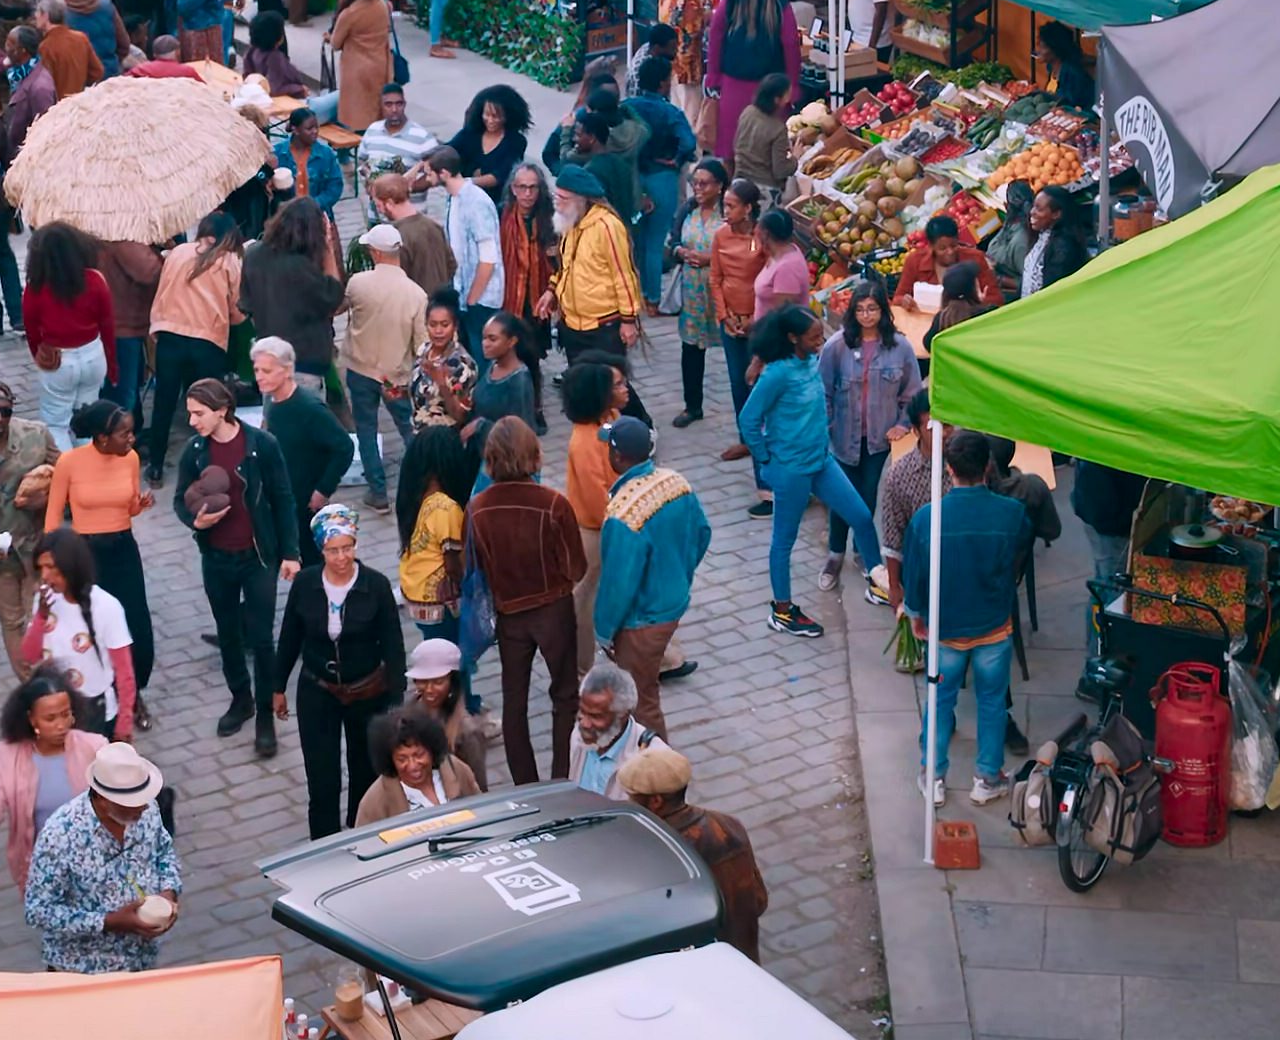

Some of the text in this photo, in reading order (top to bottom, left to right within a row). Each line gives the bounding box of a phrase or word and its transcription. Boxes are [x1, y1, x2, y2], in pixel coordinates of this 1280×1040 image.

[1120, 103, 1171, 202] THE RIB MAN
[407, 832, 557, 881] BeatsandGrind
